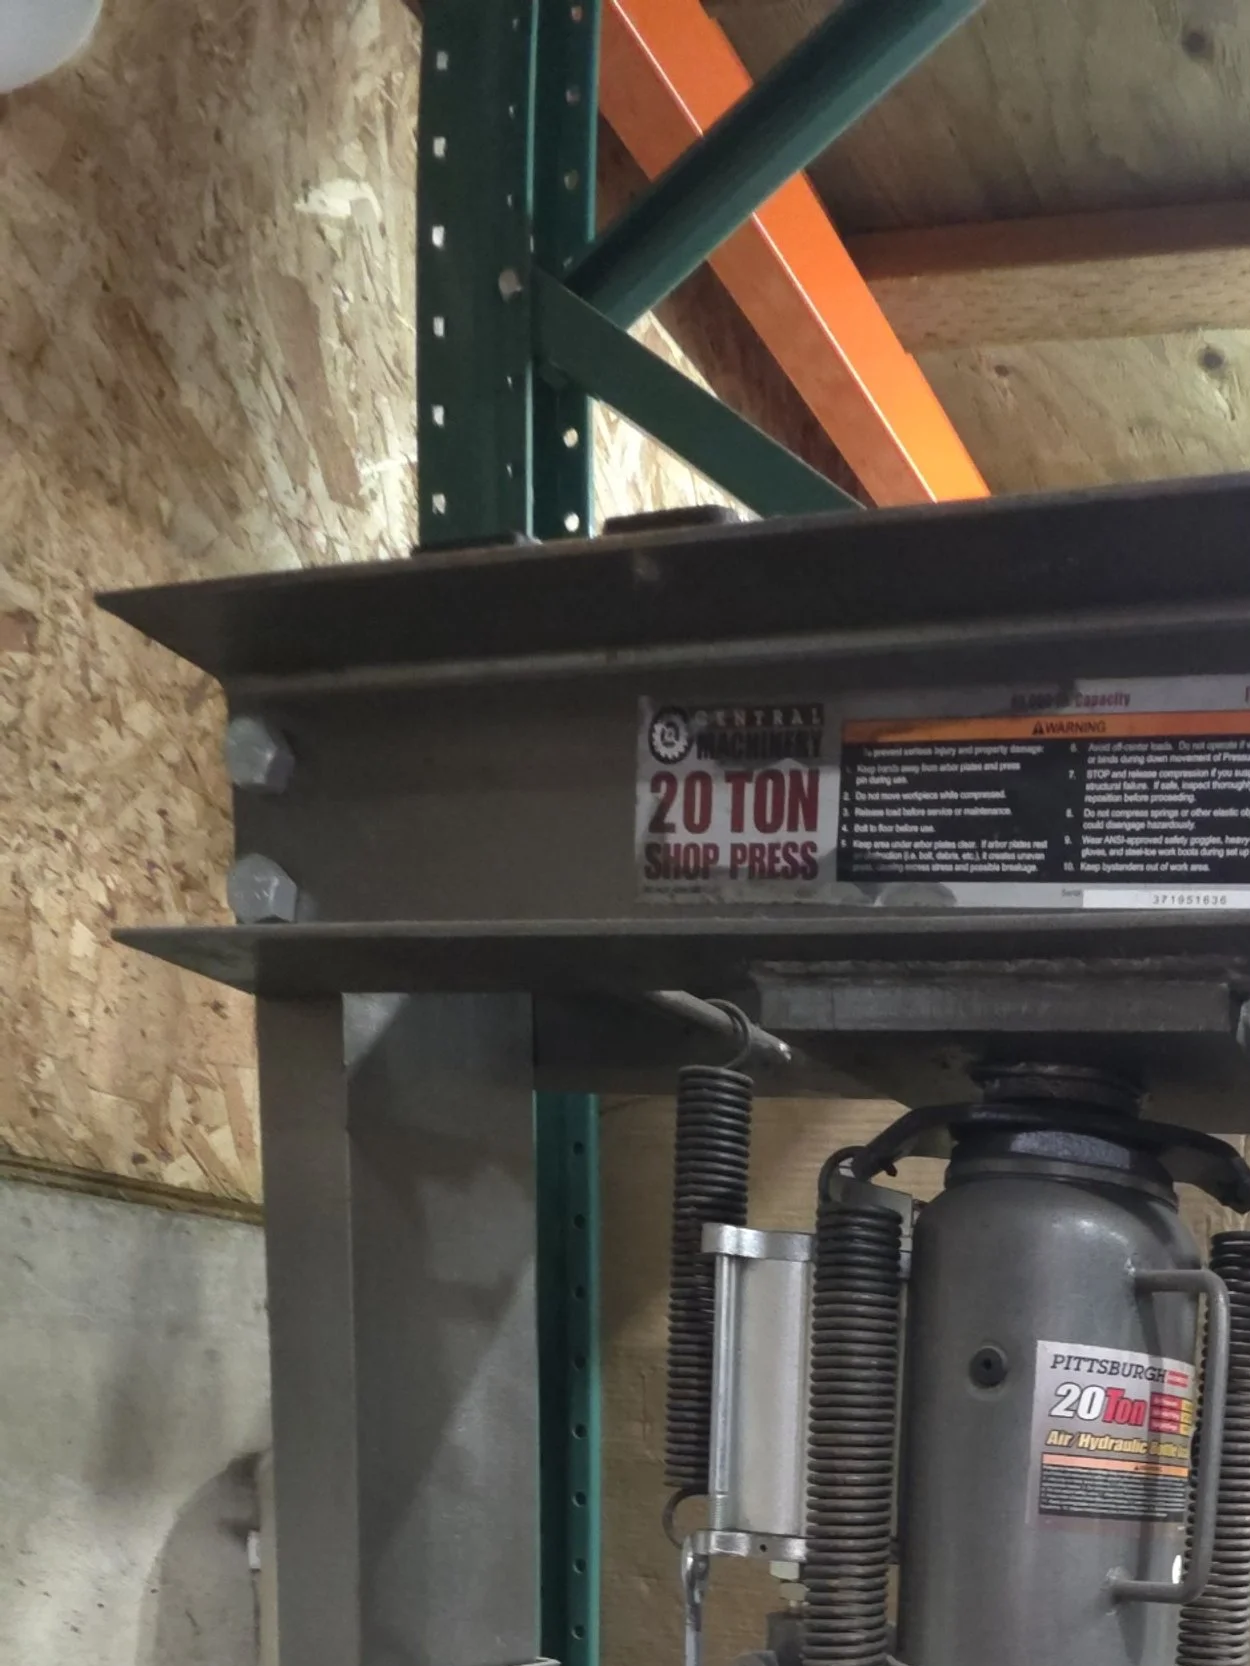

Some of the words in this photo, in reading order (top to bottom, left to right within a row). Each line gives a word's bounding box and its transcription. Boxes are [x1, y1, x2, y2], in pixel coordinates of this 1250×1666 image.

[1075, 688, 1130, 708] Capacity
[693, 707, 822, 726] CENTRAL
[1045, 720, 1106, 734] WARNING
[1086, 769, 1111, 779] STOP
[648, 770, 713, 834] 20
[725, 769, 820, 834] TON
[644, 842, 719, 880] SHOP
[730, 841, 818, 880] PRESS
[1050, 1355, 1167, 1384] PITTSBURGH
[1048, 1382, 1105, 1421] 20
